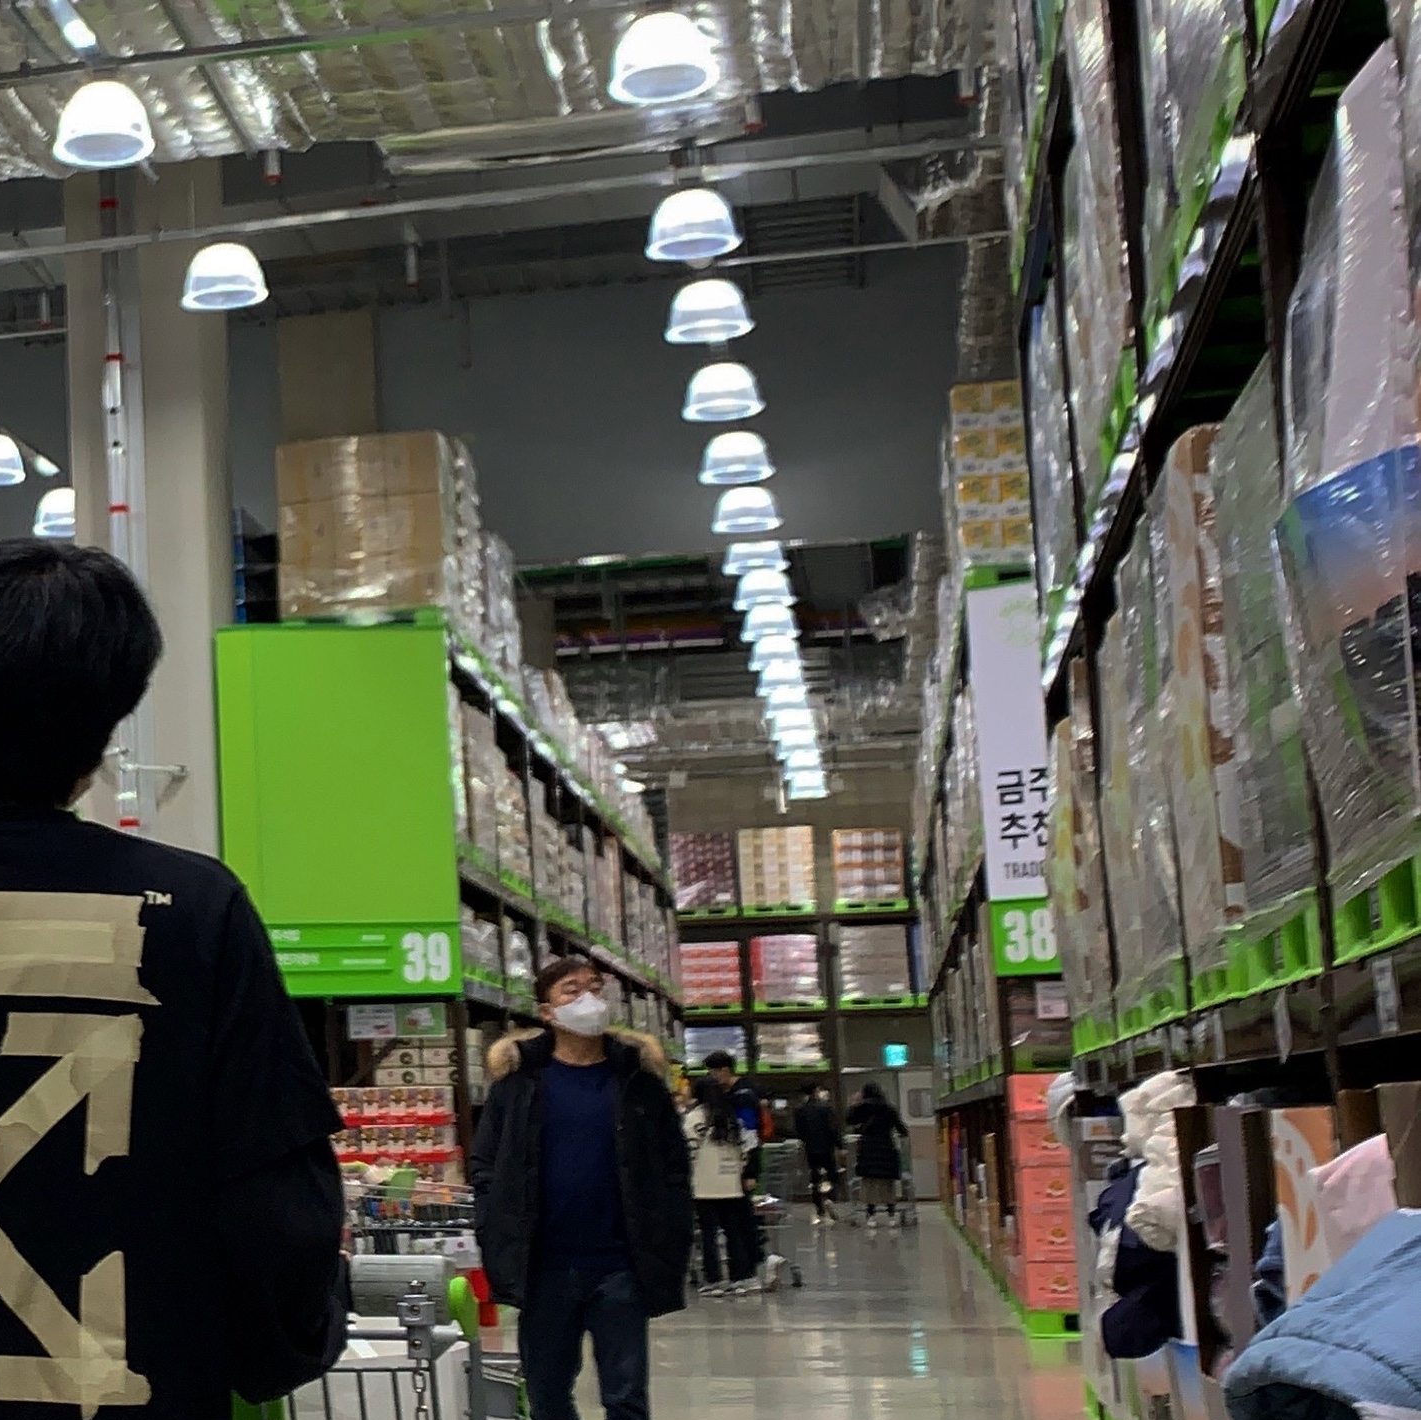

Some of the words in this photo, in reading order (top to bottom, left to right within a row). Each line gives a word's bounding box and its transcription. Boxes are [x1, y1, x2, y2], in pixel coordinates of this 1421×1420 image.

[997, 766, 1048, 806] 금주
[401, 931, 452, 983] 39
[1002, 908, 1058, 964] 38
